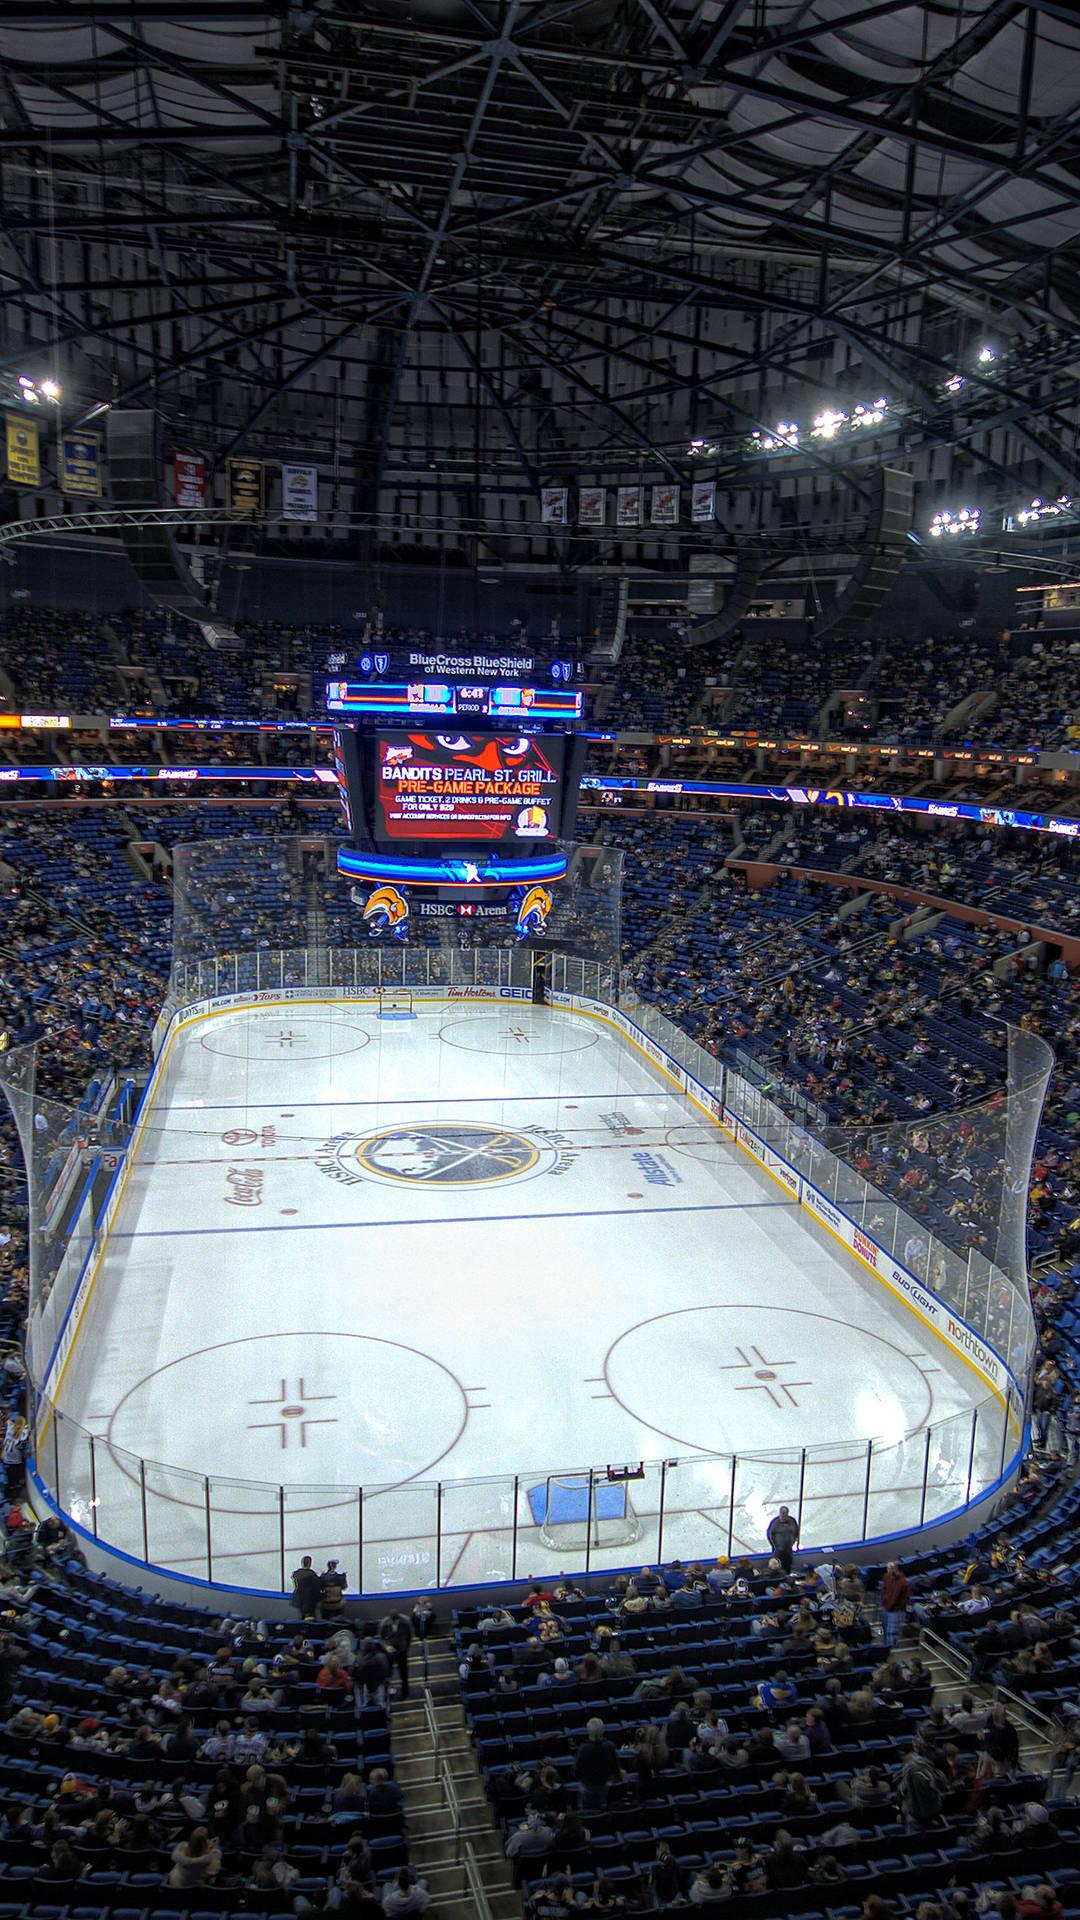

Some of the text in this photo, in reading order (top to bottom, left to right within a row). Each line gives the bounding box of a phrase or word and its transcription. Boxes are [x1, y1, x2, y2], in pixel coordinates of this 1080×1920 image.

[409, 654, 533, 669] BlueCross BlueShield
[435, 666, 476, 675] Western
[477, 667, 498, 676] New
[499, 668, 519, 677] York
[458, 704, 480, 712] PERIOD
[382, 766, 557, 783] BANDITS PEARL ST. GRILL
[397, 780, 541, 795] PRE-GAME PACKAGE
[395, 795, 416, 803] GAME
[445, 796, 451, 804] 2
[402, 803, 418, 811] FOR
[419, 803, 439, 811] ONLY
[420, 903, 508, 916] HSBC Arena
[343, 986, 370, 995] HSBC
[447, 986, 463, 997] Tim
[464, 986, 497, 998] Hortons
[500, 988, 533, 999] GEIC
[548, 1151, 581, 1176] Arena
[631, 1152, 676, 1188] Allstate
[314, 1160, 363, 1186] HSBC
[853, 1239, 877, 1267] DONUTS
[892, 1271, 939, 1315] BUD LIGHT
[948, 1320, 999, 1378] northtown
